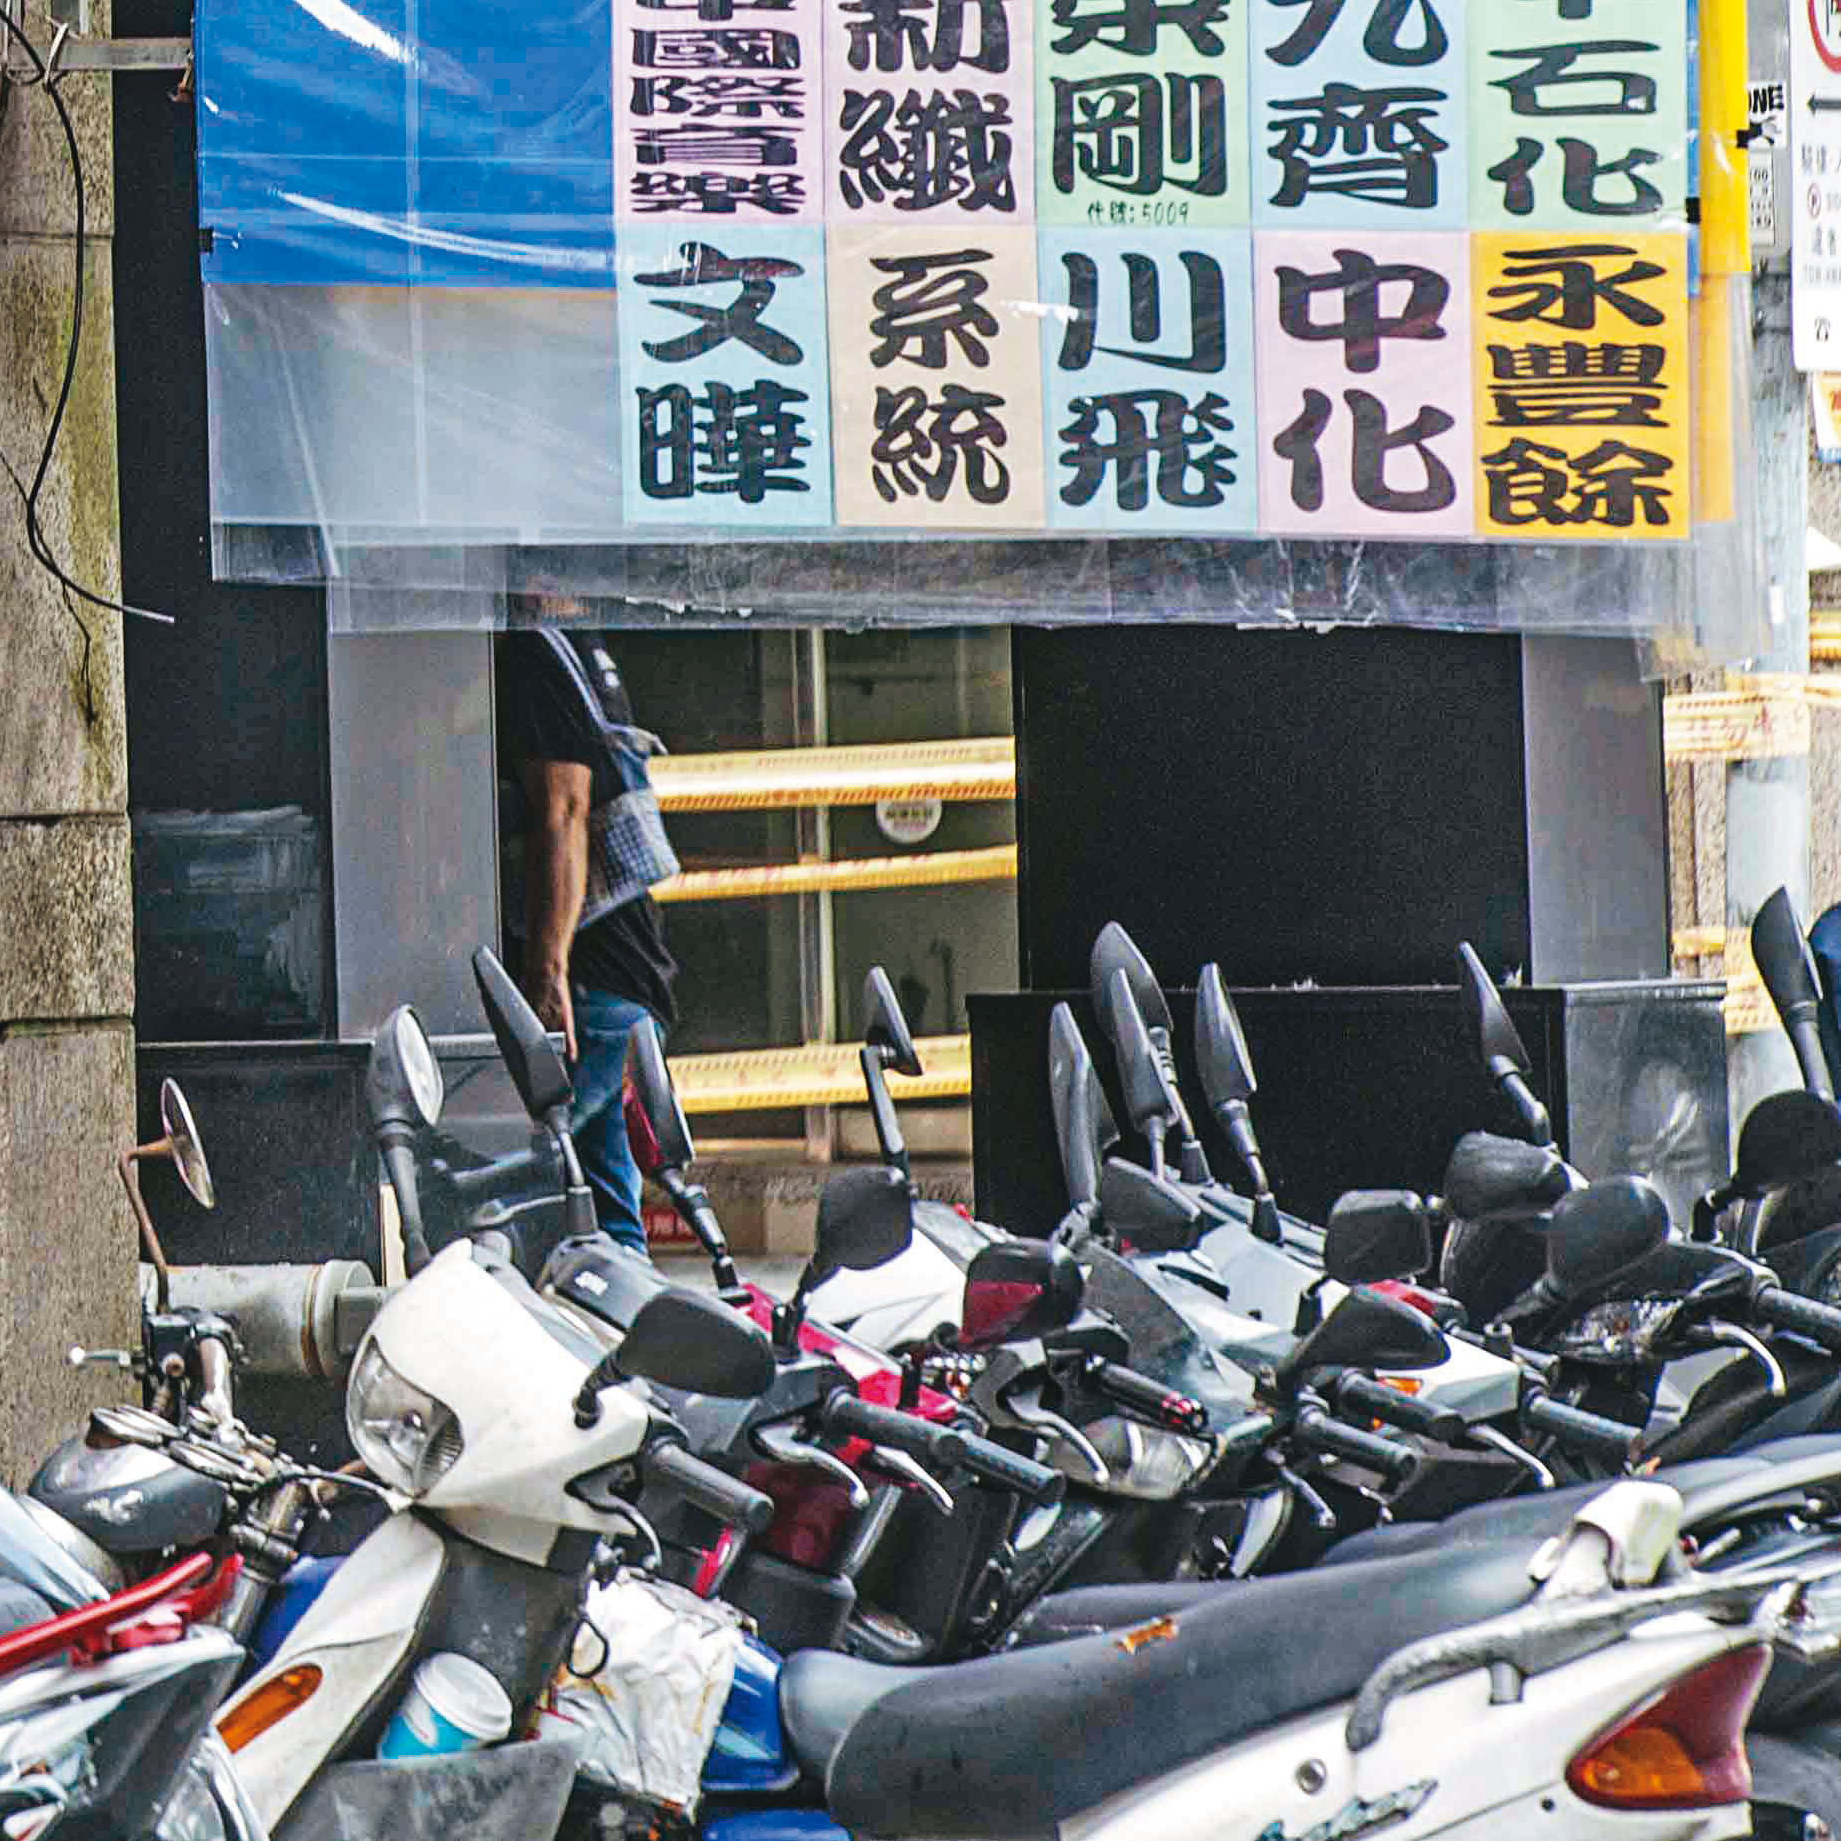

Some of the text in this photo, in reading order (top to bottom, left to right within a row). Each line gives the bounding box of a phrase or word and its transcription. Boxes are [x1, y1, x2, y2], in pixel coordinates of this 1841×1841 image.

[634, 242, 811, 503] 文曄
[870, 250, 1009, 503] 系統
[1058, 251, 1237, 511] 川飛
[1274, 250, 1455, 512] 中化
[1482, 245, 1673, 527] 永豐餘
